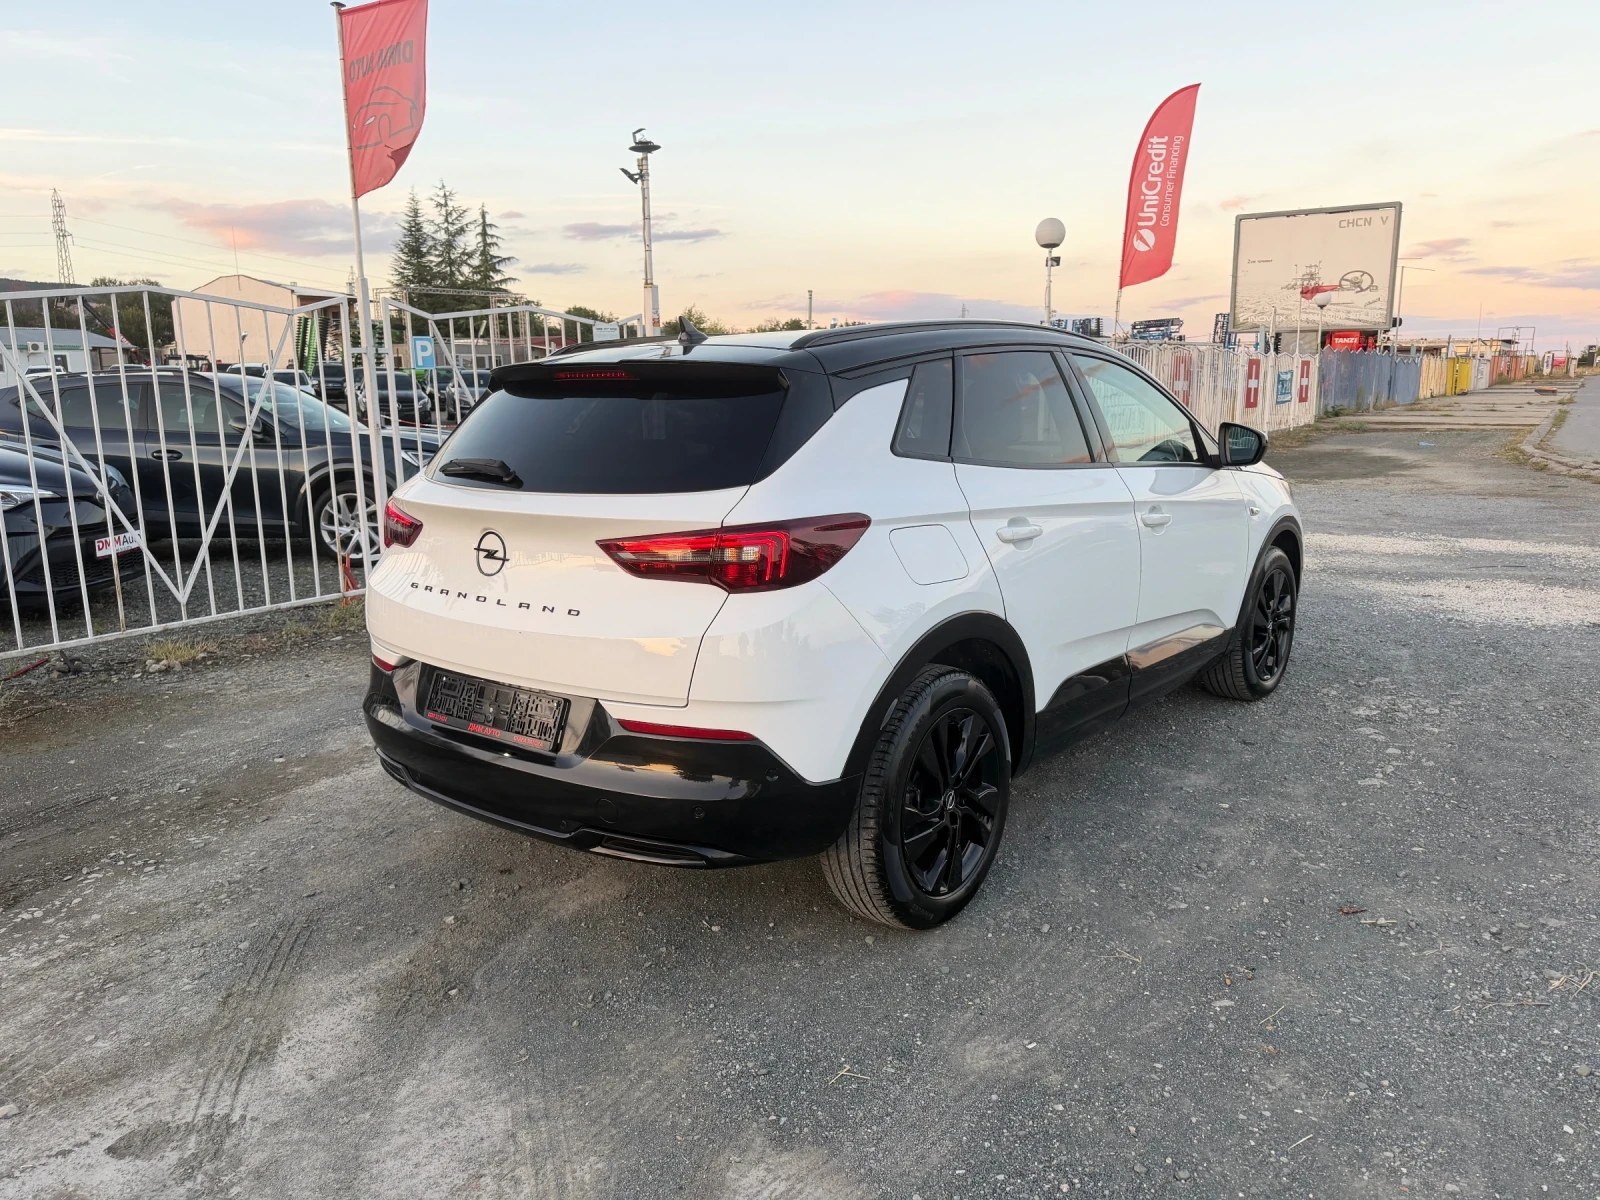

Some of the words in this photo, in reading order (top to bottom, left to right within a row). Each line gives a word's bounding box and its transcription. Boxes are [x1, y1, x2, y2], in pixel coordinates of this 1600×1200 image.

[1166, 135, 1184, 179] Financing
[1137, 135, 1168, 226] UniCredit
[1159, 181, 1175, 227] Consumer
[415, 340, 433, 366] P
[410, 581, 581, 617] GRANDLAND
